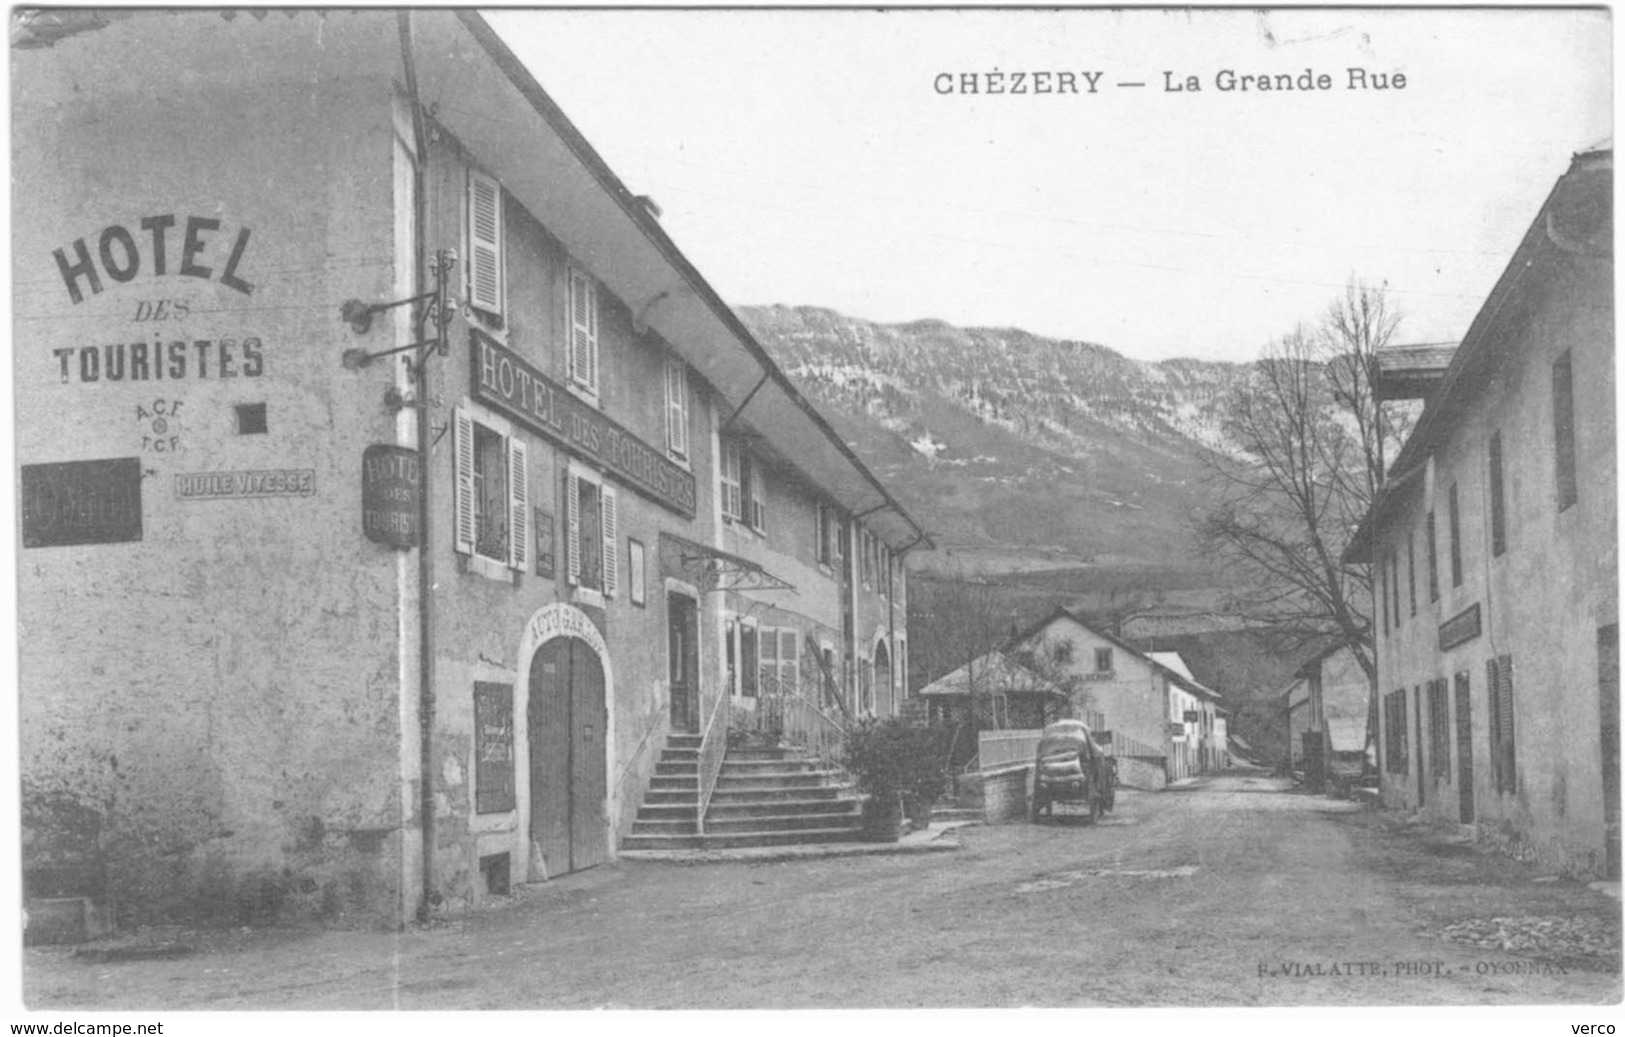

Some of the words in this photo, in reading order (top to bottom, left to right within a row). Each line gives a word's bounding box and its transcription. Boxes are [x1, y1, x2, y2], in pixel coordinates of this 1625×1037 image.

[52, 213, 256, 304] HOTEL
[133, 300, 191, 323] DES
[479, 341, 562, 430] HOTEL
[572, 412, 599, 454] DES
[181, 475, 234, 496] HUILE
[235, 473, 312, 495] VITESSE
